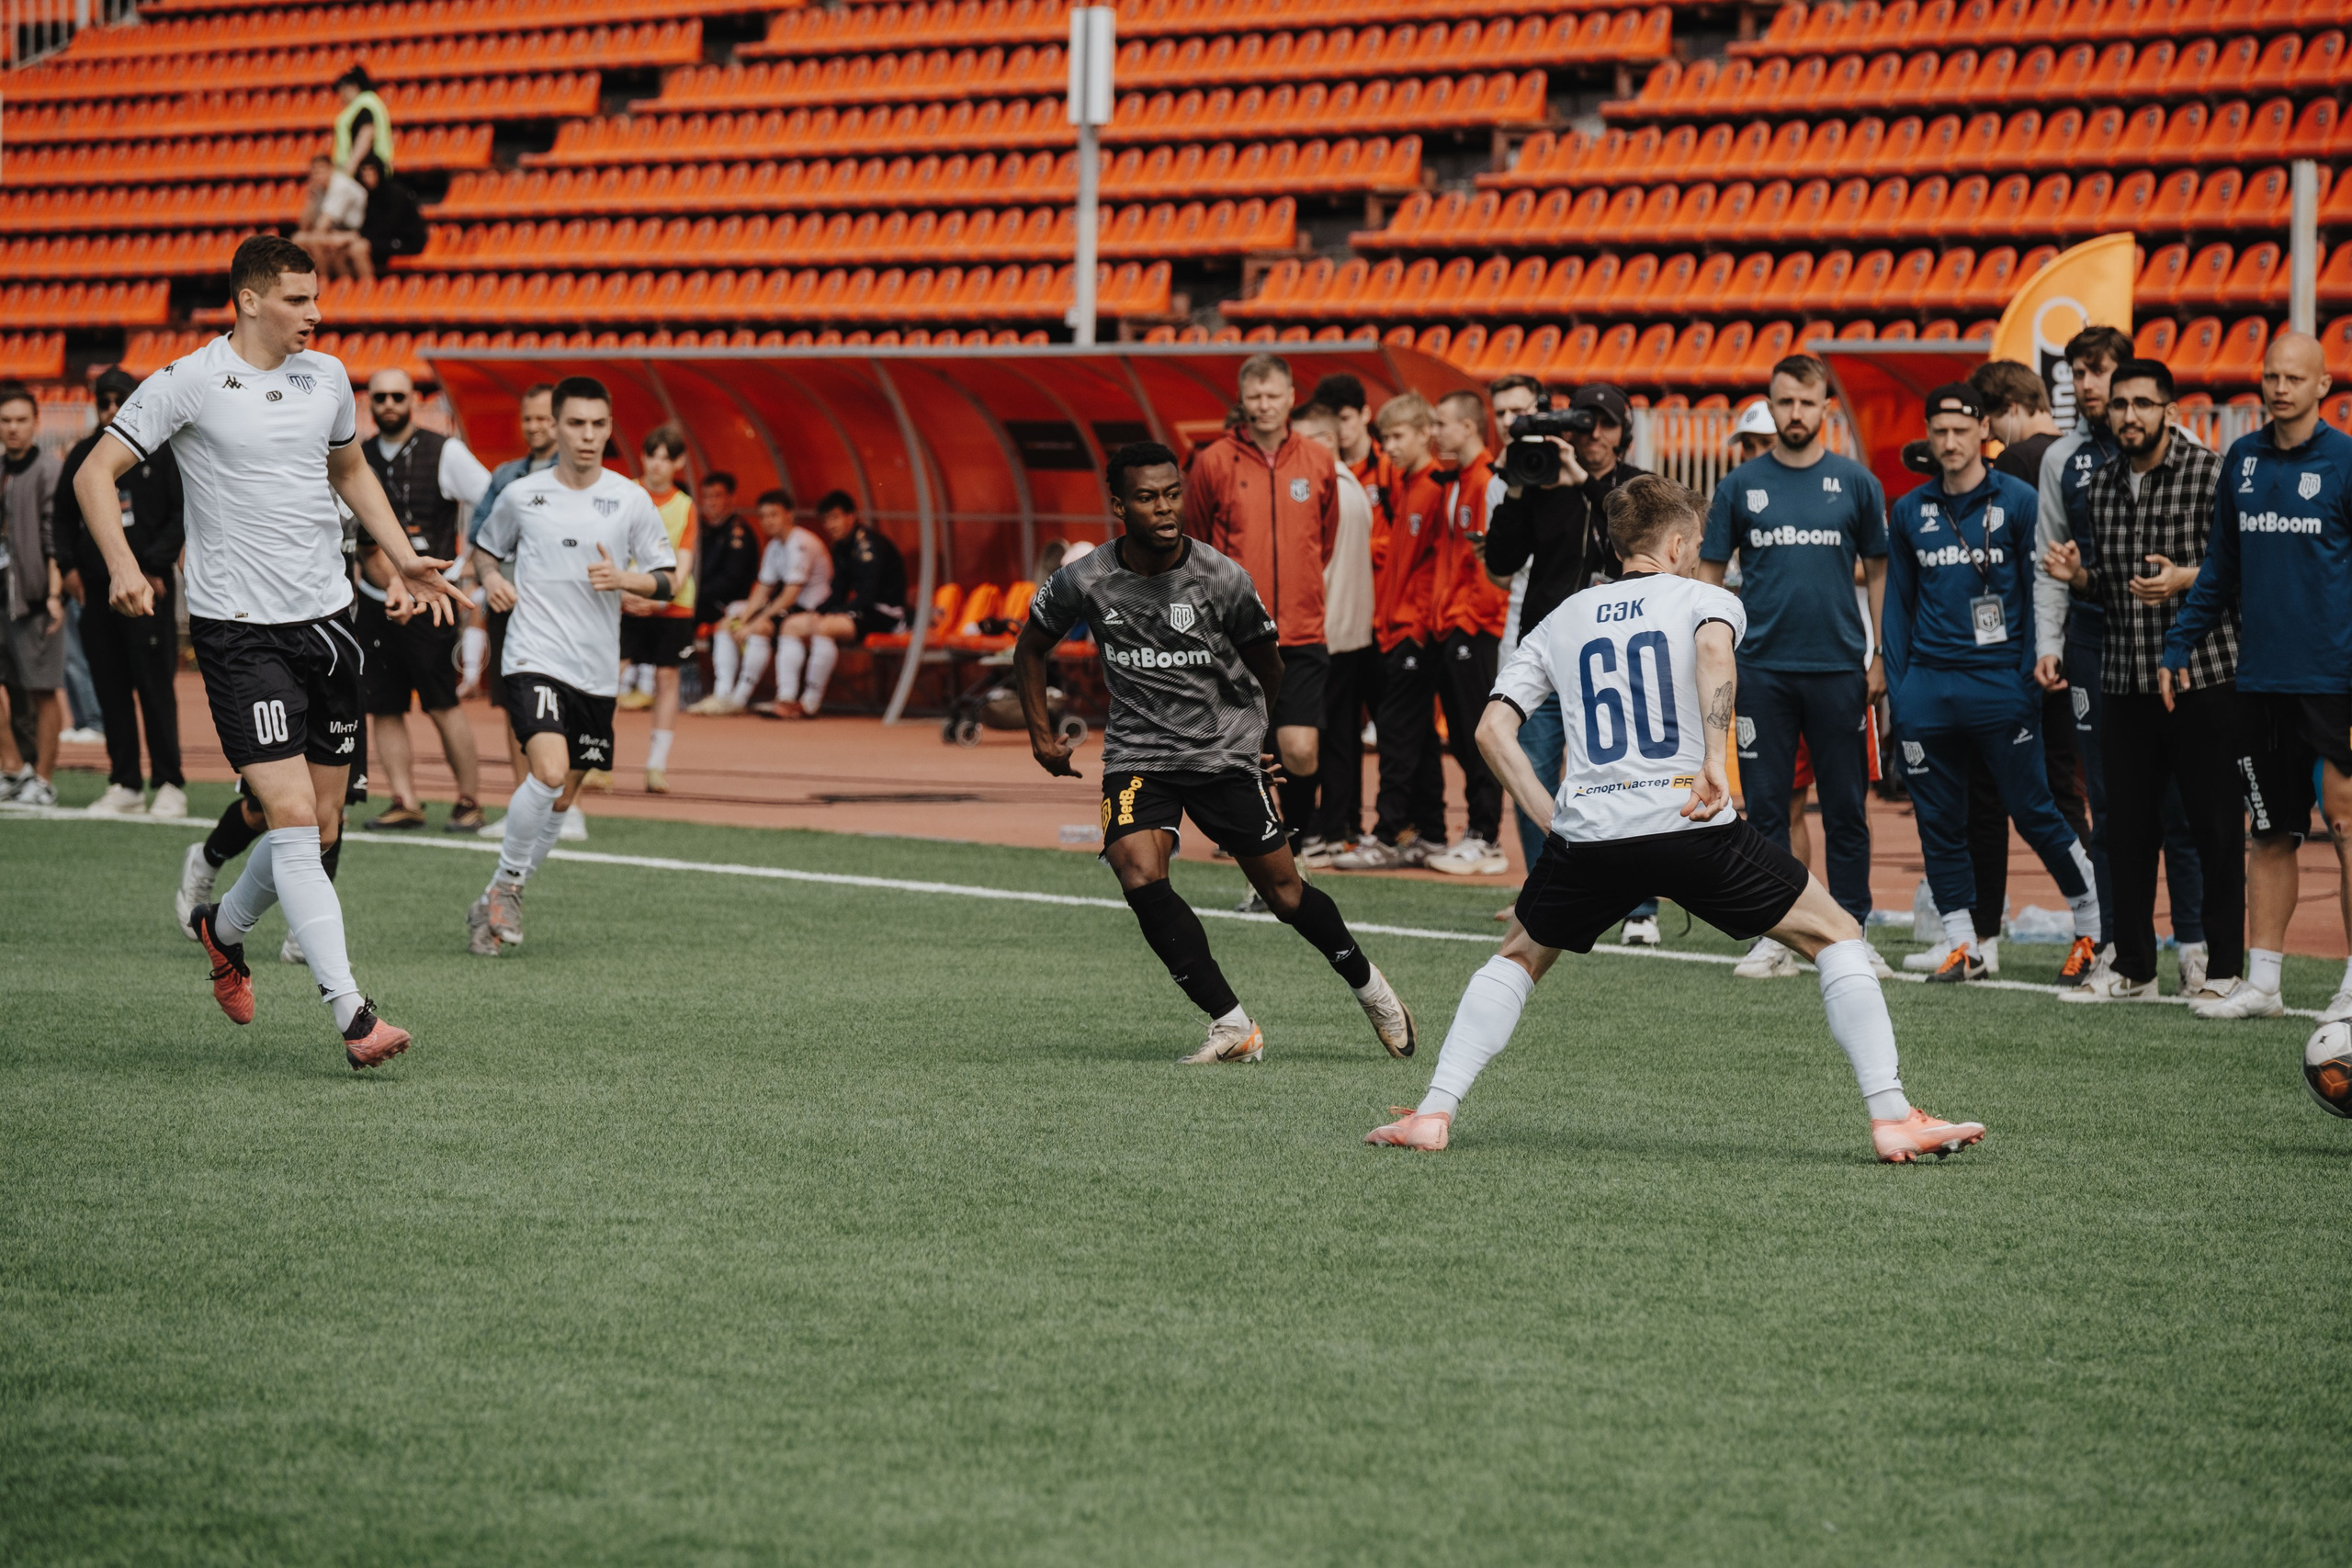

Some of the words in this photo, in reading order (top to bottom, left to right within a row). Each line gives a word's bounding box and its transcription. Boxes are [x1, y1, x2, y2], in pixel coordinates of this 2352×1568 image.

[2052, 360, 2076, 435] line
[2242, 456, 2258, 477] 97
[1750, 525, 1841, 547] BetBoom
[2239, 511, 2322, 534] BetBoom
[1104, 642, 1212, 669] BetBoom
[533, 685, 560, 722] 74
[1579, 630, 1680, 765] 60
[253, 699, 288, 745] 00
[1673, 777, 1694, 788] PR
[2243, 755, 2271, 830] BetBoom
